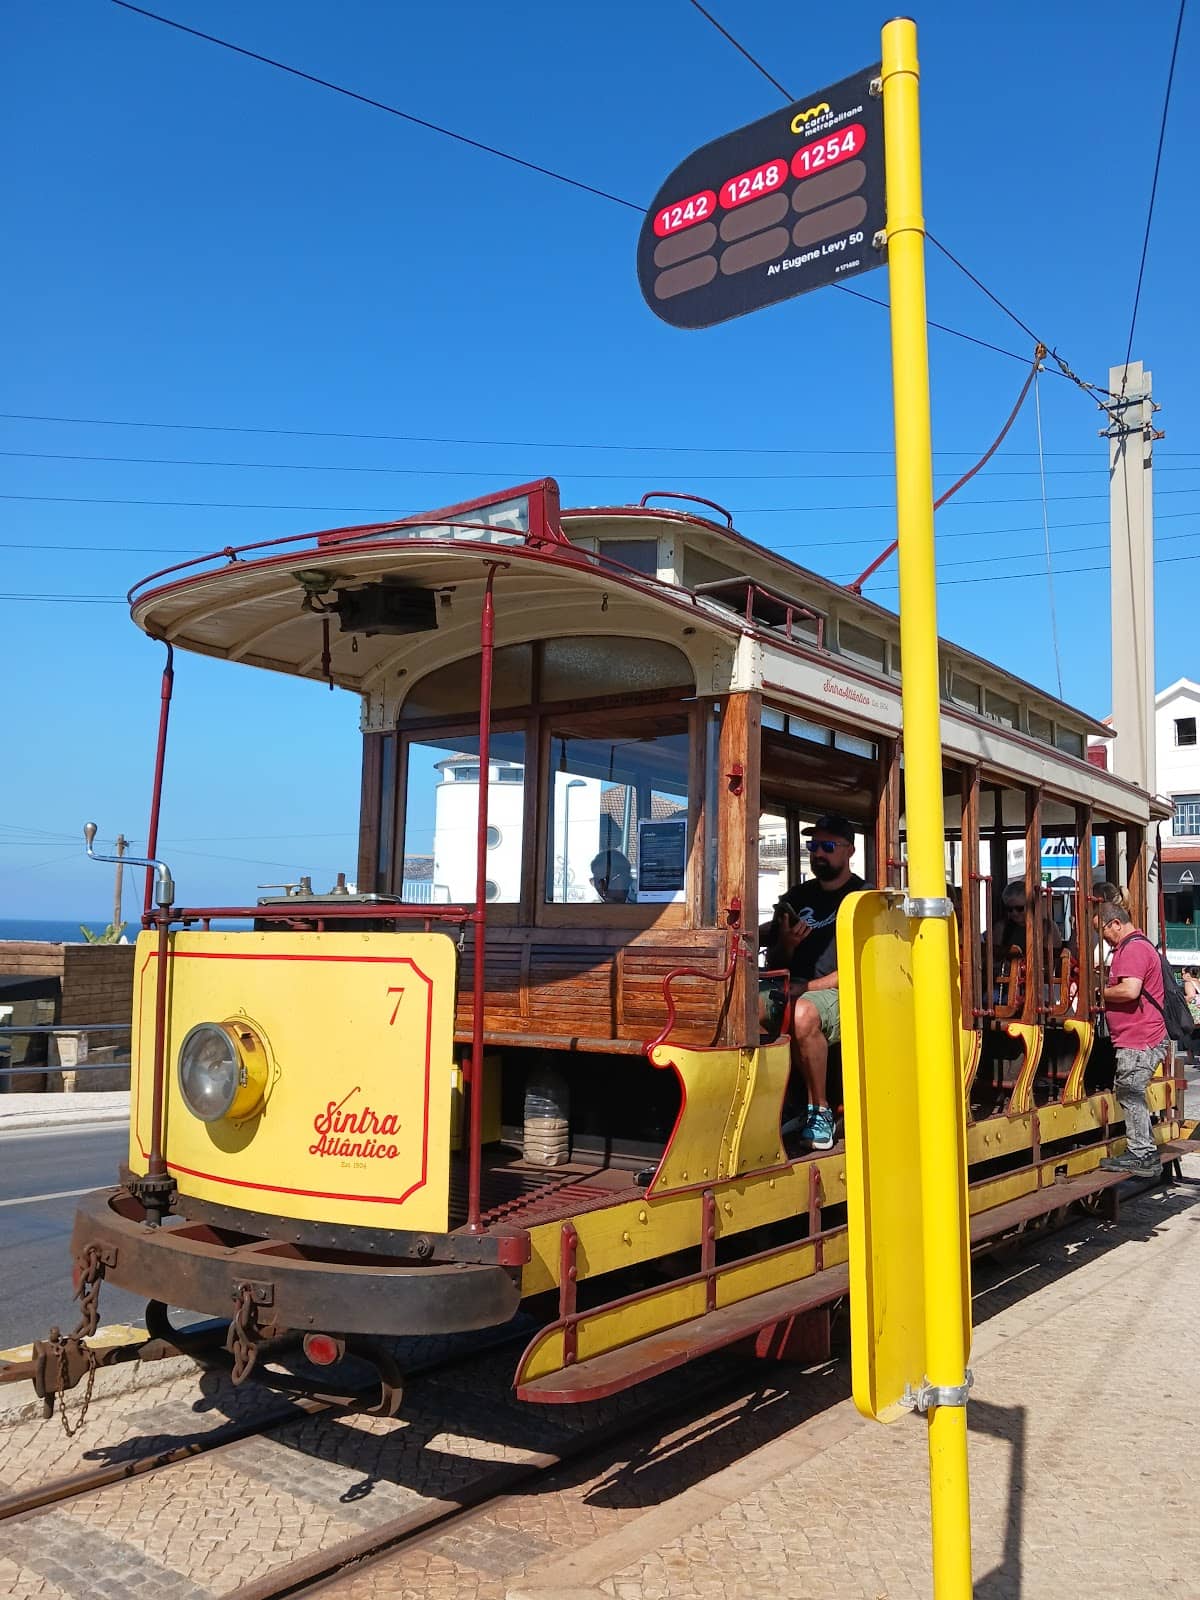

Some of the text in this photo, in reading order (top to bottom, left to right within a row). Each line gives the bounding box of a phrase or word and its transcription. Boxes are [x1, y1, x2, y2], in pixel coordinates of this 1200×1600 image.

[804, 111, 834, 130] carris
[804, 105, 863, 137] metropolitana
[662, 130, 856, 230] 1242 1248 1254
[767, 231, 864, 276] Av Eugene Levy 50
[386, 986, 406, 1026] 7
[313, 1086, 402, 1136] Sintra
[308, 1134, 401, 1159] Atlântico
